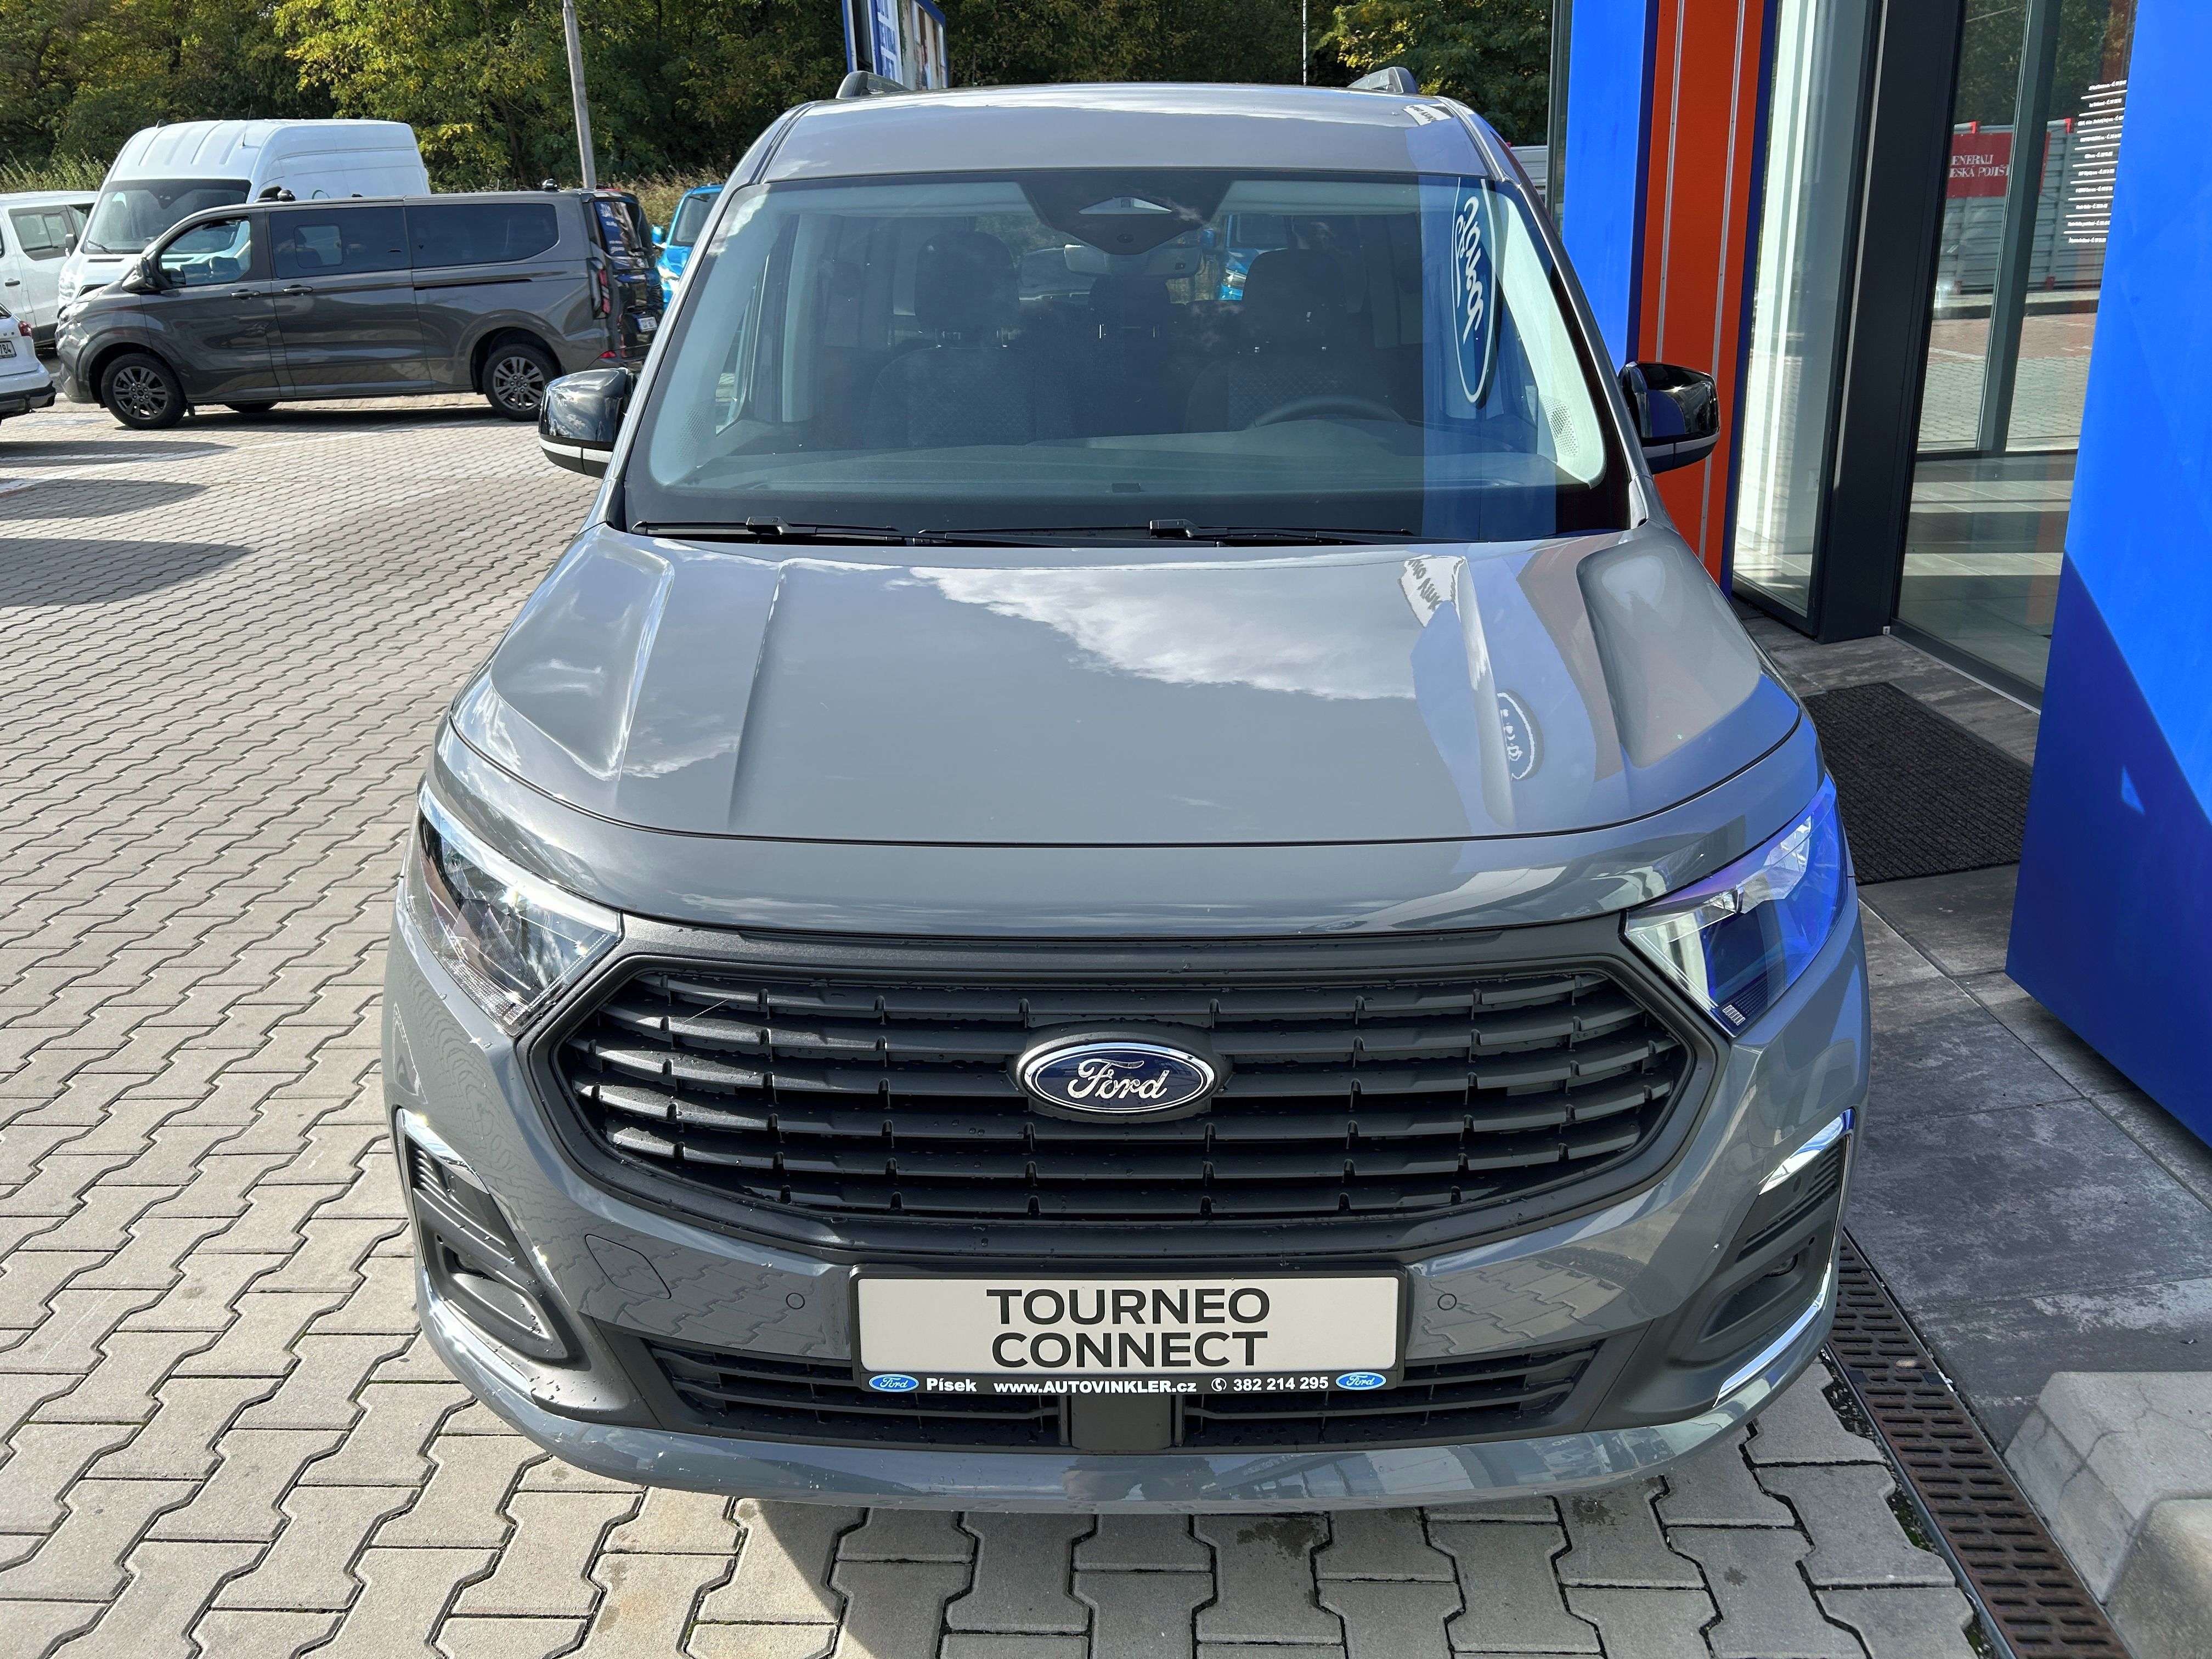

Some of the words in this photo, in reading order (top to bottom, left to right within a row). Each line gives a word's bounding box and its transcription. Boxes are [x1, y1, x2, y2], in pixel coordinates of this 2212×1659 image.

[1949, 165, 1975, 178] ESKÁ
[1951, 155, 1994, 165] ENERALI
[1067, 1058, 1170, 1099] Ford
[986, 1288, 1270, 1325] TOURNEO
[992, 1331, 1268, 1368] CONNECT
[879, 1376, 909, 1388] Ford
[926, 1378, 977, 1392] Písek
[994, 1380, 1197, 1393] www.AUTOVINKLER.cz
[1233, 1378, 1262, 1391] 382
[1266, 1377, 1296, 1390] 214
[1299, 1376, 1329, 1390] 295
[1346, 1374, 1375, 1386] Ford
